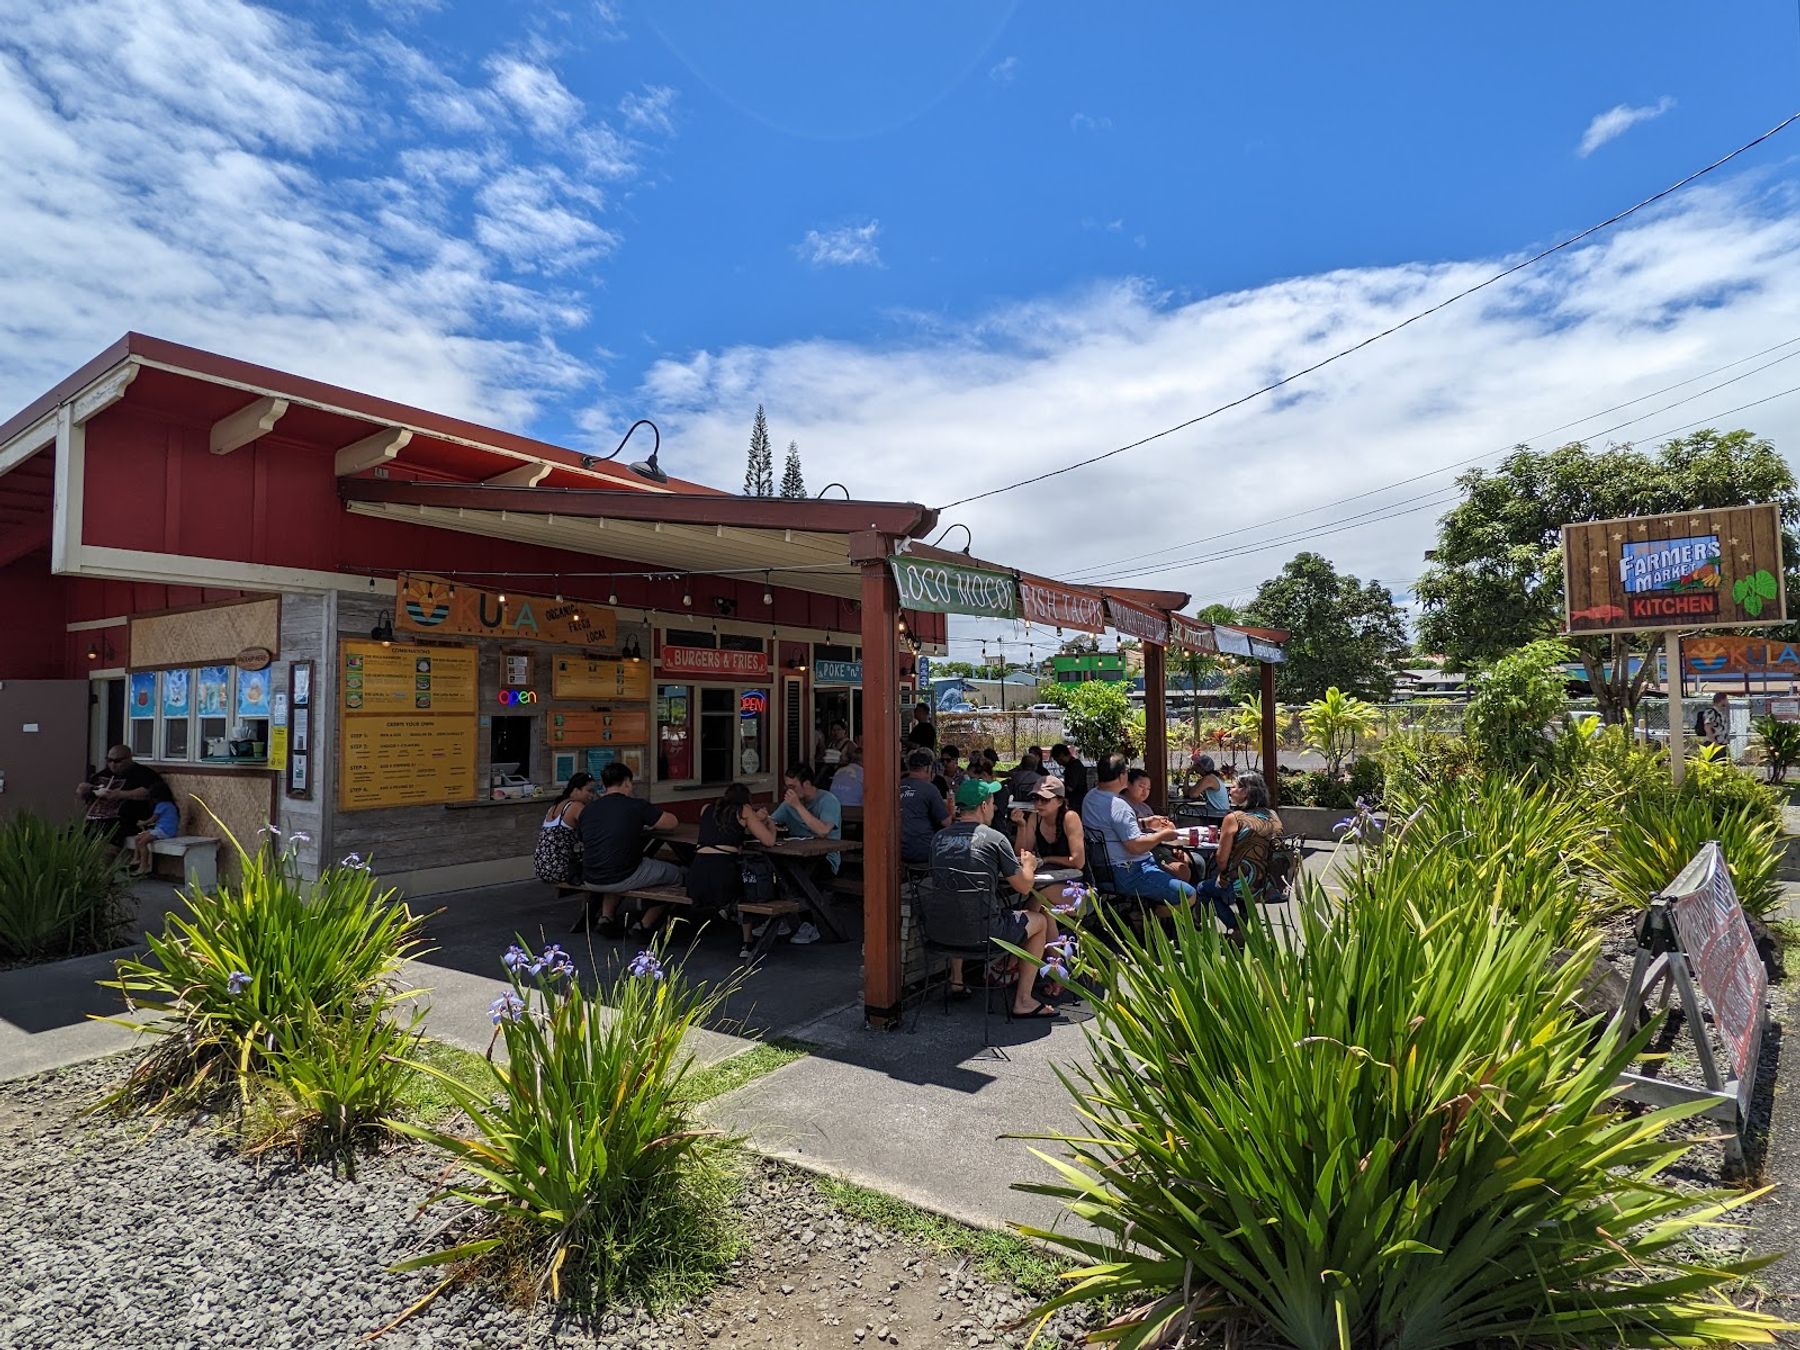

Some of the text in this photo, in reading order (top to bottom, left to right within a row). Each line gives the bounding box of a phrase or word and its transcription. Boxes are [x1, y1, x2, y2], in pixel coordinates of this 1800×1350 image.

[1620, 541, 1721, 582] FARMERS
[892, 562, 1013, 610] LOCO MOCOS
[1635, 563, 1697, 593] MARKET
[456, 593, 540, 631] KULA
[545, 604, 576, 621] ORGANIC
[1021, 584, 1058, 619] FISH
[1062, 594, 1104, 628] TACOS
[1633, 596, 1714, 616] KITCHEN
[568, 618, 591, 633] FRESH
[585, 628, 607, 644] LOCAL
[674, 649, 759, 670] BURGERS & FRIES
[1729, 644, 1800, 665] KULA
[823, 663, 845, 678] POKE
[498, 689, 537, 707] open
